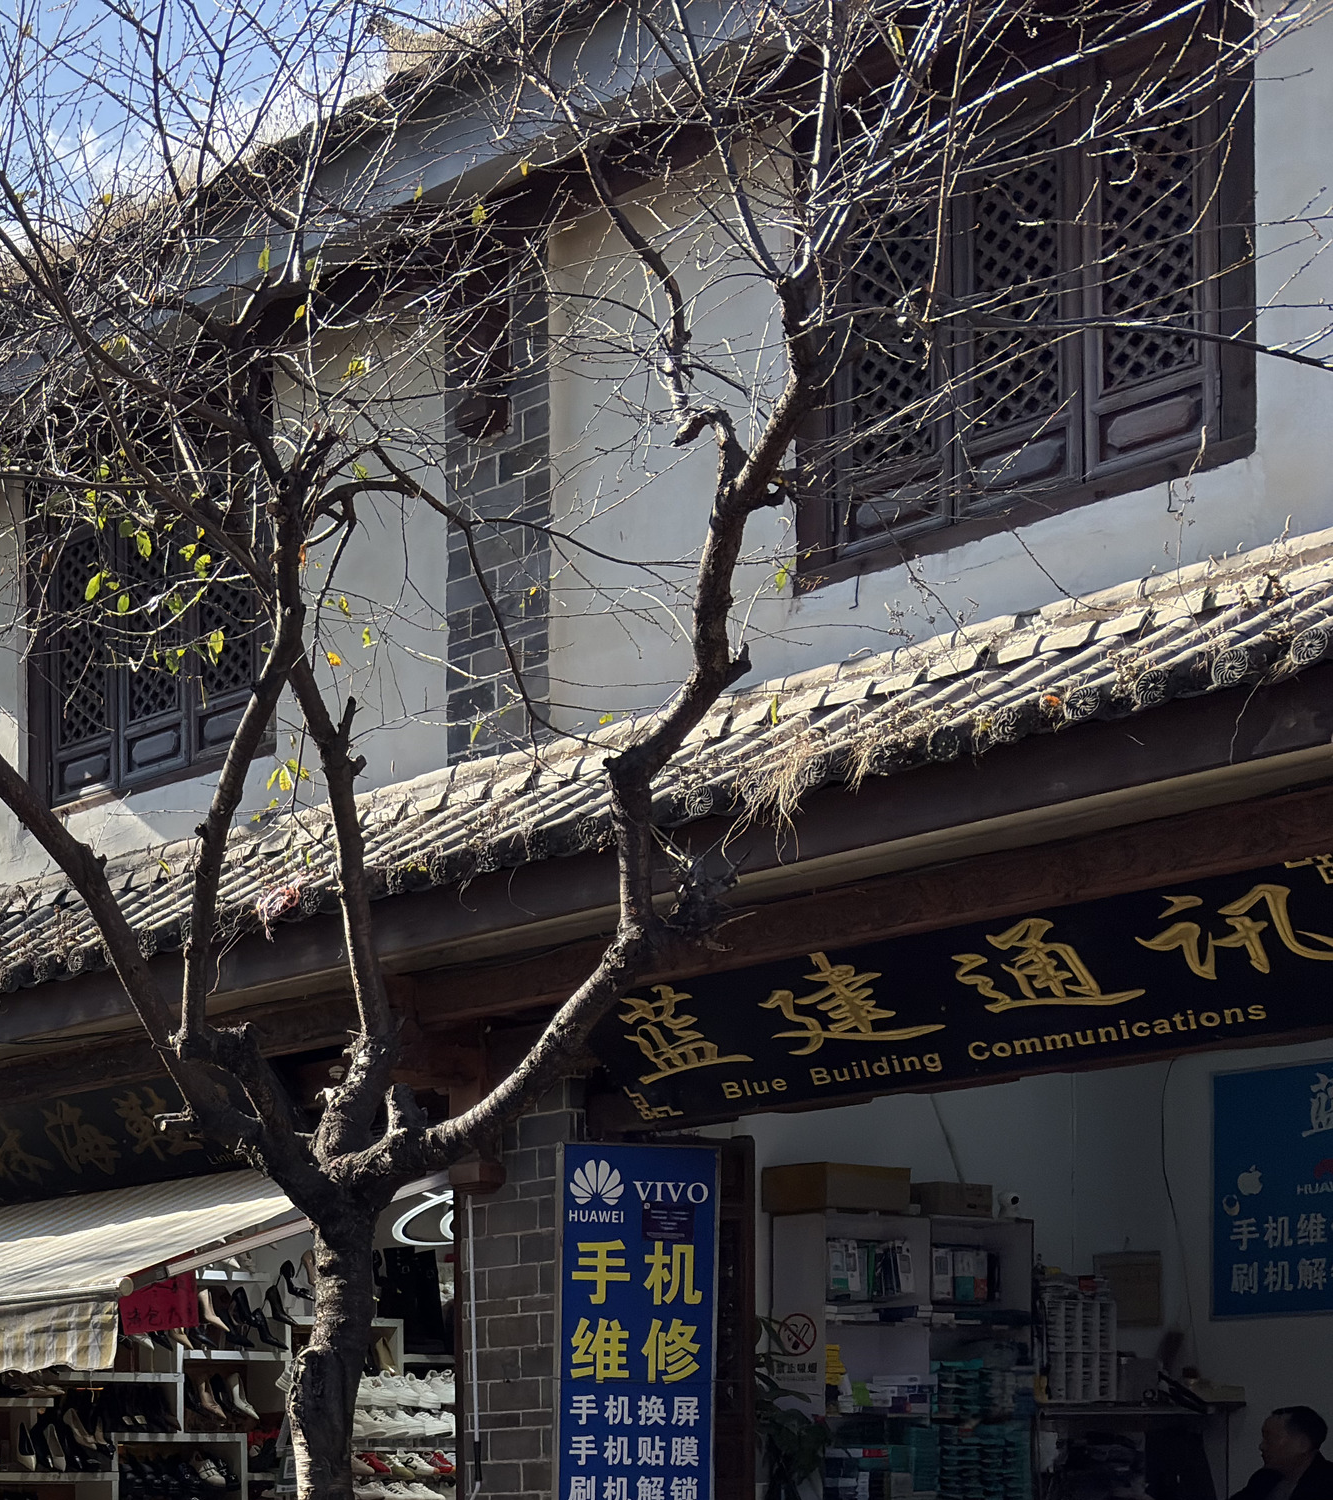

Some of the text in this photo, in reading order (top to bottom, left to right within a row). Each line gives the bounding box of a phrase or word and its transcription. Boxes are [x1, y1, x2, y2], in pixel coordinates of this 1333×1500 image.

[721, 1001, 1267, 1100] Blue Building Communications
[633, 1181, 709, 1204] VIVO
[568, 1209, 624, 1223] HUAWEI
[1230, 1213, 1333, 1251] 手机维
[571, 1239, 703, 1305] 手机
[1230, 1257, 1333, 1295] 刷机解
[570, 1317, 701, 1384] 维修
[569, 1395, 700, 1426] 手机换屏
[568, 1436, 700, 1467] 手机贴膜
